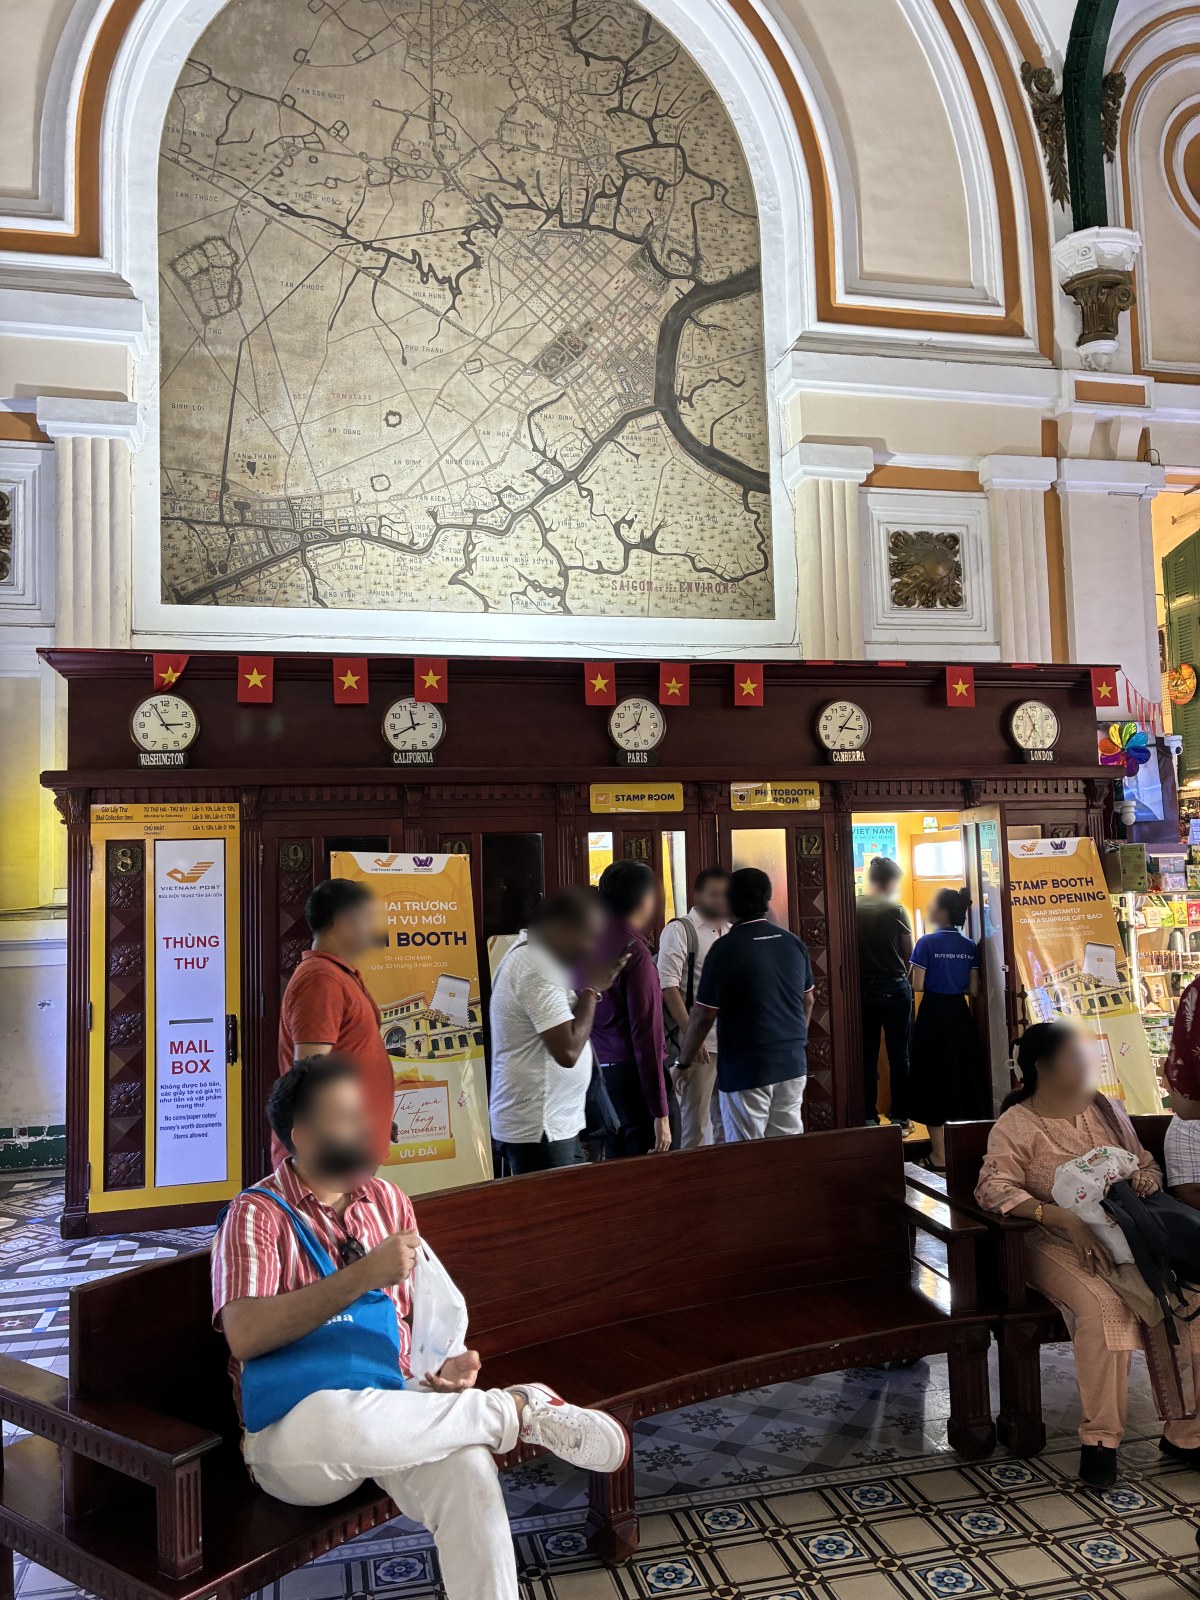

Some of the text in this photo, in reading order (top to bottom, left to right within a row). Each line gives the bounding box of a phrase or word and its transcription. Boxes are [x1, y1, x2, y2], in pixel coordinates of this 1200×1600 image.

[297, 87, 310, 95] TAN
[328, 92, 346, 100] NHUT
[167, 126, 180, 134] TAN
[175, 191, 218, 202] TAN THUOC
[301, 283, 325, 291] PHUOC
[421, 346, 444, 354] THANH
[271, 482, 299, 490] CHOLON
[611, 579, 738, 594] SAIGON ENVIRONS
[140, 752, 184, 765] WASHINGTON
[393, 752, 433, 763] CALIFORNIA
[627, 752, 648, 763] PARIS
[832, 750, 865, 761] CANBERRA
[1030, 750, 1054, 761] LONDON
[615, 793, 675, 802] STAMP ROOM
[755, 788, 815, 797] PHOTOBOOTH
[627, 836, 649, 859] 11
[800, 834, 823, 856] 12
[117, 848, 134, 872] 8
[288, 844, 304, 867] 9
[1009, 876, 1094, 891] STAMP BOOTH
[1050, 890, 1106, 904] OPENING
[405, 901, 457, 911] TRƯƠNG
[1031, 907, 1081, 917] SNAP INSTANTLY
[400, 915, 418, 928] VỤ
[421, 913, 446, 925] MỚI
[1042, 915, 1071, 923] SURPRISE
[162, 933, 220, 949] THÙNG
[396, 931, 467, 947] BOOTH
[174, 957, 209, 970] THƯ
[169, 1039, 214, 1055] MAIL
[171, 1059, 211, 1075] BOX
[195, 1121, 222, 1129] documents
